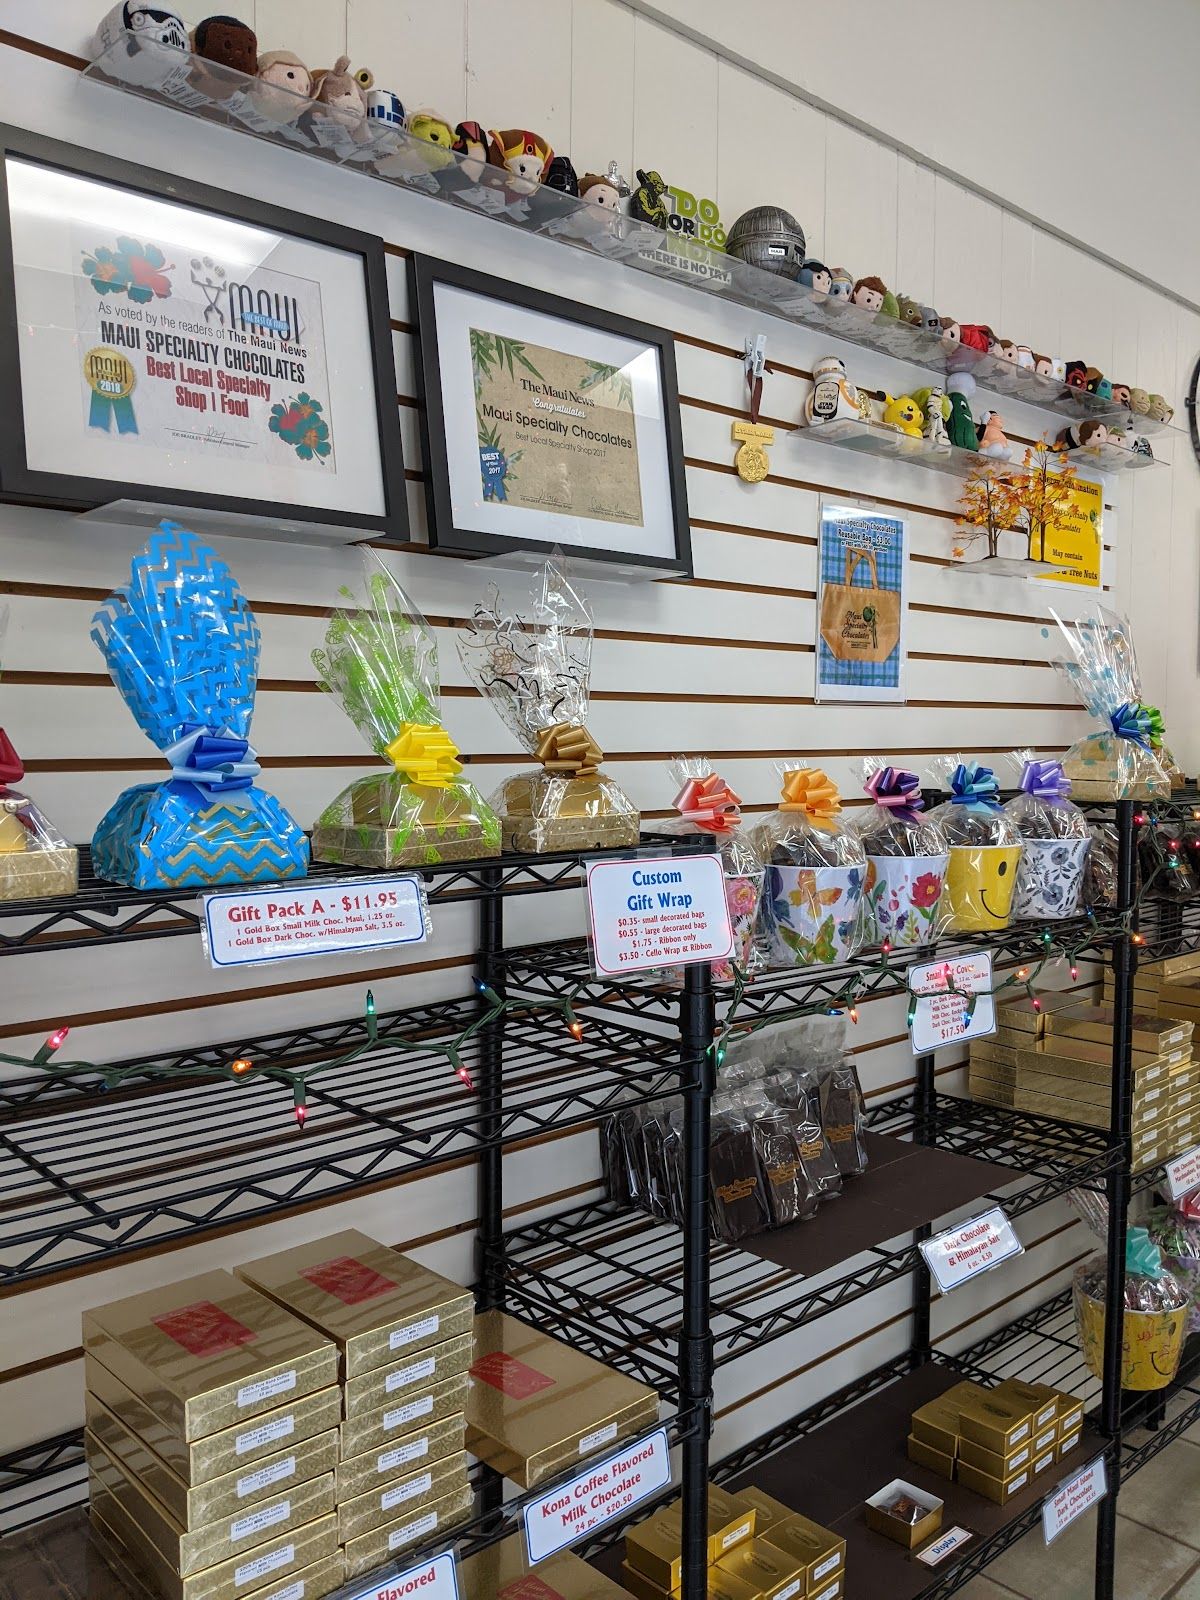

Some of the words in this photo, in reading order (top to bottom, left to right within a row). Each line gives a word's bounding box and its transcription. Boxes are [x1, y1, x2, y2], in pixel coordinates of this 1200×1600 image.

[668, 214, 694, 235] OR
[700, 224, 726, 246] DO
[640, 249, 677, 266] THERE
[680, 258, 688, 269] IS
[691, 262, 707, 274] NO
[99, 301, 111, 314] As
[115, 306, 142, 321] voted
[146, 311, 157, 326] by
[160, 313, 175, 328] the
[179, 318, 213, 336] readers
[216, 326, 225, 339] of
[228, 330, 246, 344] The
[251, 336, 275, 350] Maui
[281, 342, 307, 358] News
[101, 321, 140, 349] MAUI
[146, 330, 218, 365] SPECIALTY
[225, 347, 305, 384] CHOCOLATES
[100, 380, 120, 393] 2018
[147, 356, 176, 380] Best
[180, 362, 213, 387] Local
[217, 370, 270, 401] Specialty
[176, 386, 206, 412] Shop
[221, 395, 249, 418] Food
[520, 378, 540, 393] The
[543, 384, 567, 400] Maui
[569, 389, 595, 407] News
[533, 397, 586, 418] Congratulates
[483, 404, 512, 422] Maui
[516, 412, 568, 436] Specialty
[572, 425, 632, 449] Chocolates
[516, 432, 528, 441] Best
[531, 433, 547, 446] Local
[549, 438, 576, 453] Specialty
[577, 445, 593, 456] Shop
[838, 529, 860, 540] Reusable
[863, 534, 871, 543] Bag
[847, 518, 869, 530] Specialty
[871, 522, 896, 533] Chocolates
[1053, 549, 1063, 558] May
[1065, 552, 1083, 560] contain
[1069, 569, 1082, 577] Tree
[1084, 569, 1097, 580] Nuts
[632, 870, 682, 886] Custom
[228, 906, 261, 922] Gift
[268, 902, 305, 919] Pack
[311, 899, 325, 914] A
[342, 892, 397, 912] $11.95
[627, 894, 653, 911] Gift
[657, 892, 692, 909] Wrap
[245, 924, 262, 935] Gold
[266, 924, 280, 932] Box
[283, 920, 302, 931] Small
[304, 918, 320, 928] Milk
[323, 916, 342, 926] Choc.
[346, 914, 364, 924] Maui,
[367, 912, 383, 921] 1.25
[619, 928, 637, 938] $0.55
[645, 925, 660, 936] large
[662, 922, 691, 933] decorated
[694, 921, 707, 931] bags
[642, 913, 658, 924] small
[660, 911, 689, 922] decorated
[692, 911, 705, 919] bags
[236, 936, 254, 946] Gold
[257, 935, 271, 944] Box
[275, 932, 292, 941] Dark
[295, 930, 316, 940] Choc.
[318, 925, 362, 938] w/Himalayan
[364, 922, 379, 932] Salt,
[382, 921, 392, 929] 3.5
[632, 938, 652, 948] $1.75
[659, 935, 682, 944] Ribbon
[684, 933, 696, 942] only
[619, 952, 639, 962] $3.50
[646, 949, 662, 958] Cello
[664, 946, 680, 956] Wrap
[691, 942, 712, 951] Ribbon
[941, 1025, 965, 1039] $17.50
[944, 1239, 960, 1251] Dark
[961, 1223, 991, 1243] Chocolate
[949, 1258, 956, 1266] &
[956, 1242, 988, 1262] Himalayan
[988, 1234, 1000, 1245] Salt
[542, 1495, 570, 1518] Kona
[574, 1473, 609, 1499] Coffee
[612, 1443, 654, 1478] Flavored
[1054, 1492, 1066, 1508] Small
[1067, 1481, 1079, 1496] Maui
[1080, 1470, 1093, 1486] Island
[561, 1504, 587, 1527] Milk
[591, 1473, 641, 1509] Chocolate
[1057, 1504, 1068, 1518] Dark
[1070, 1485, 1092, 1506] Chocolate
[575, 1522, 585, 1534] 24
[587, 1518, 598, 1528] pc.
[606, 1493, 632, 1515] $20.50
[933, 1536, 957, 1555] Display
[377, 1567, 436, 1600] Flavored
